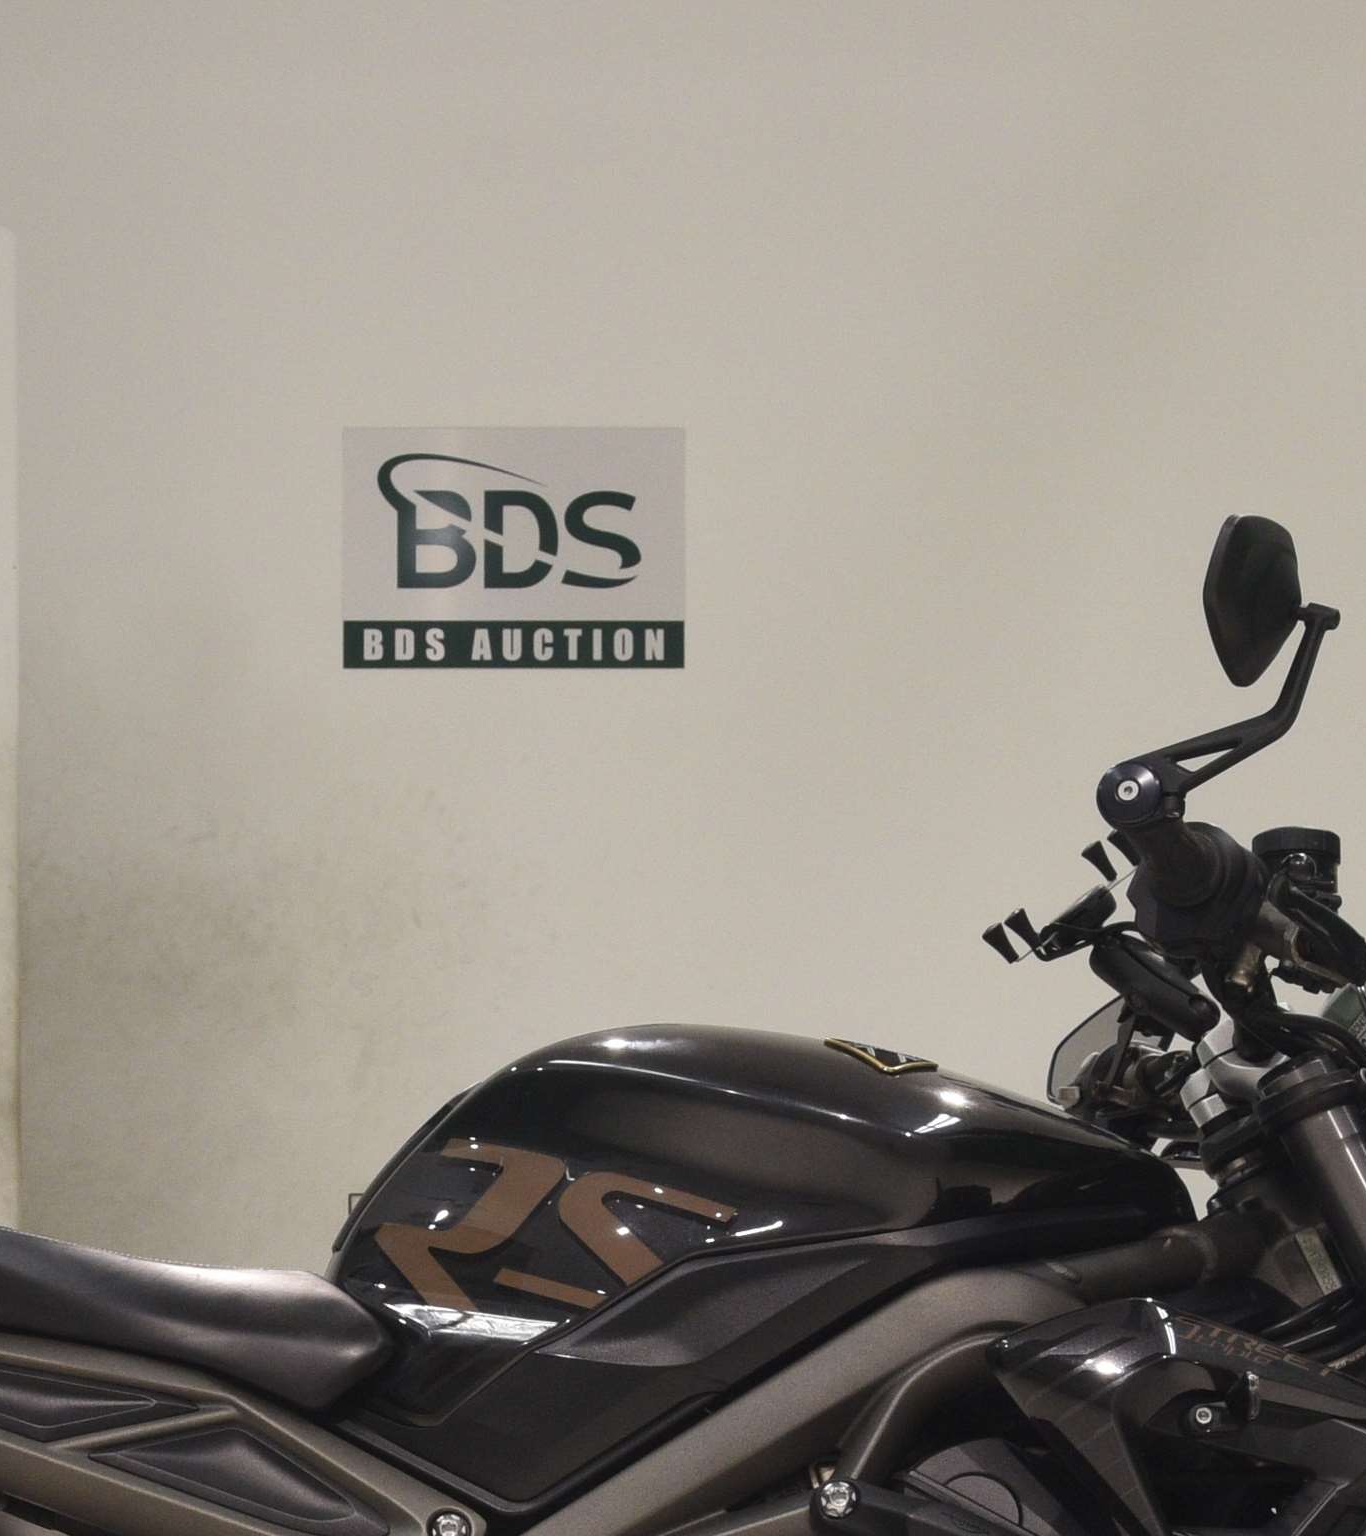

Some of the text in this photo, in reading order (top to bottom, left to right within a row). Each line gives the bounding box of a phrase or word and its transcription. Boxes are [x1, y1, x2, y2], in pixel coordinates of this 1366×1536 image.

[377, 453, 641, 589] BDS
[363, 628, 664, 661] BDS AUCTION
[374, 1138, 737, 1312] RS
